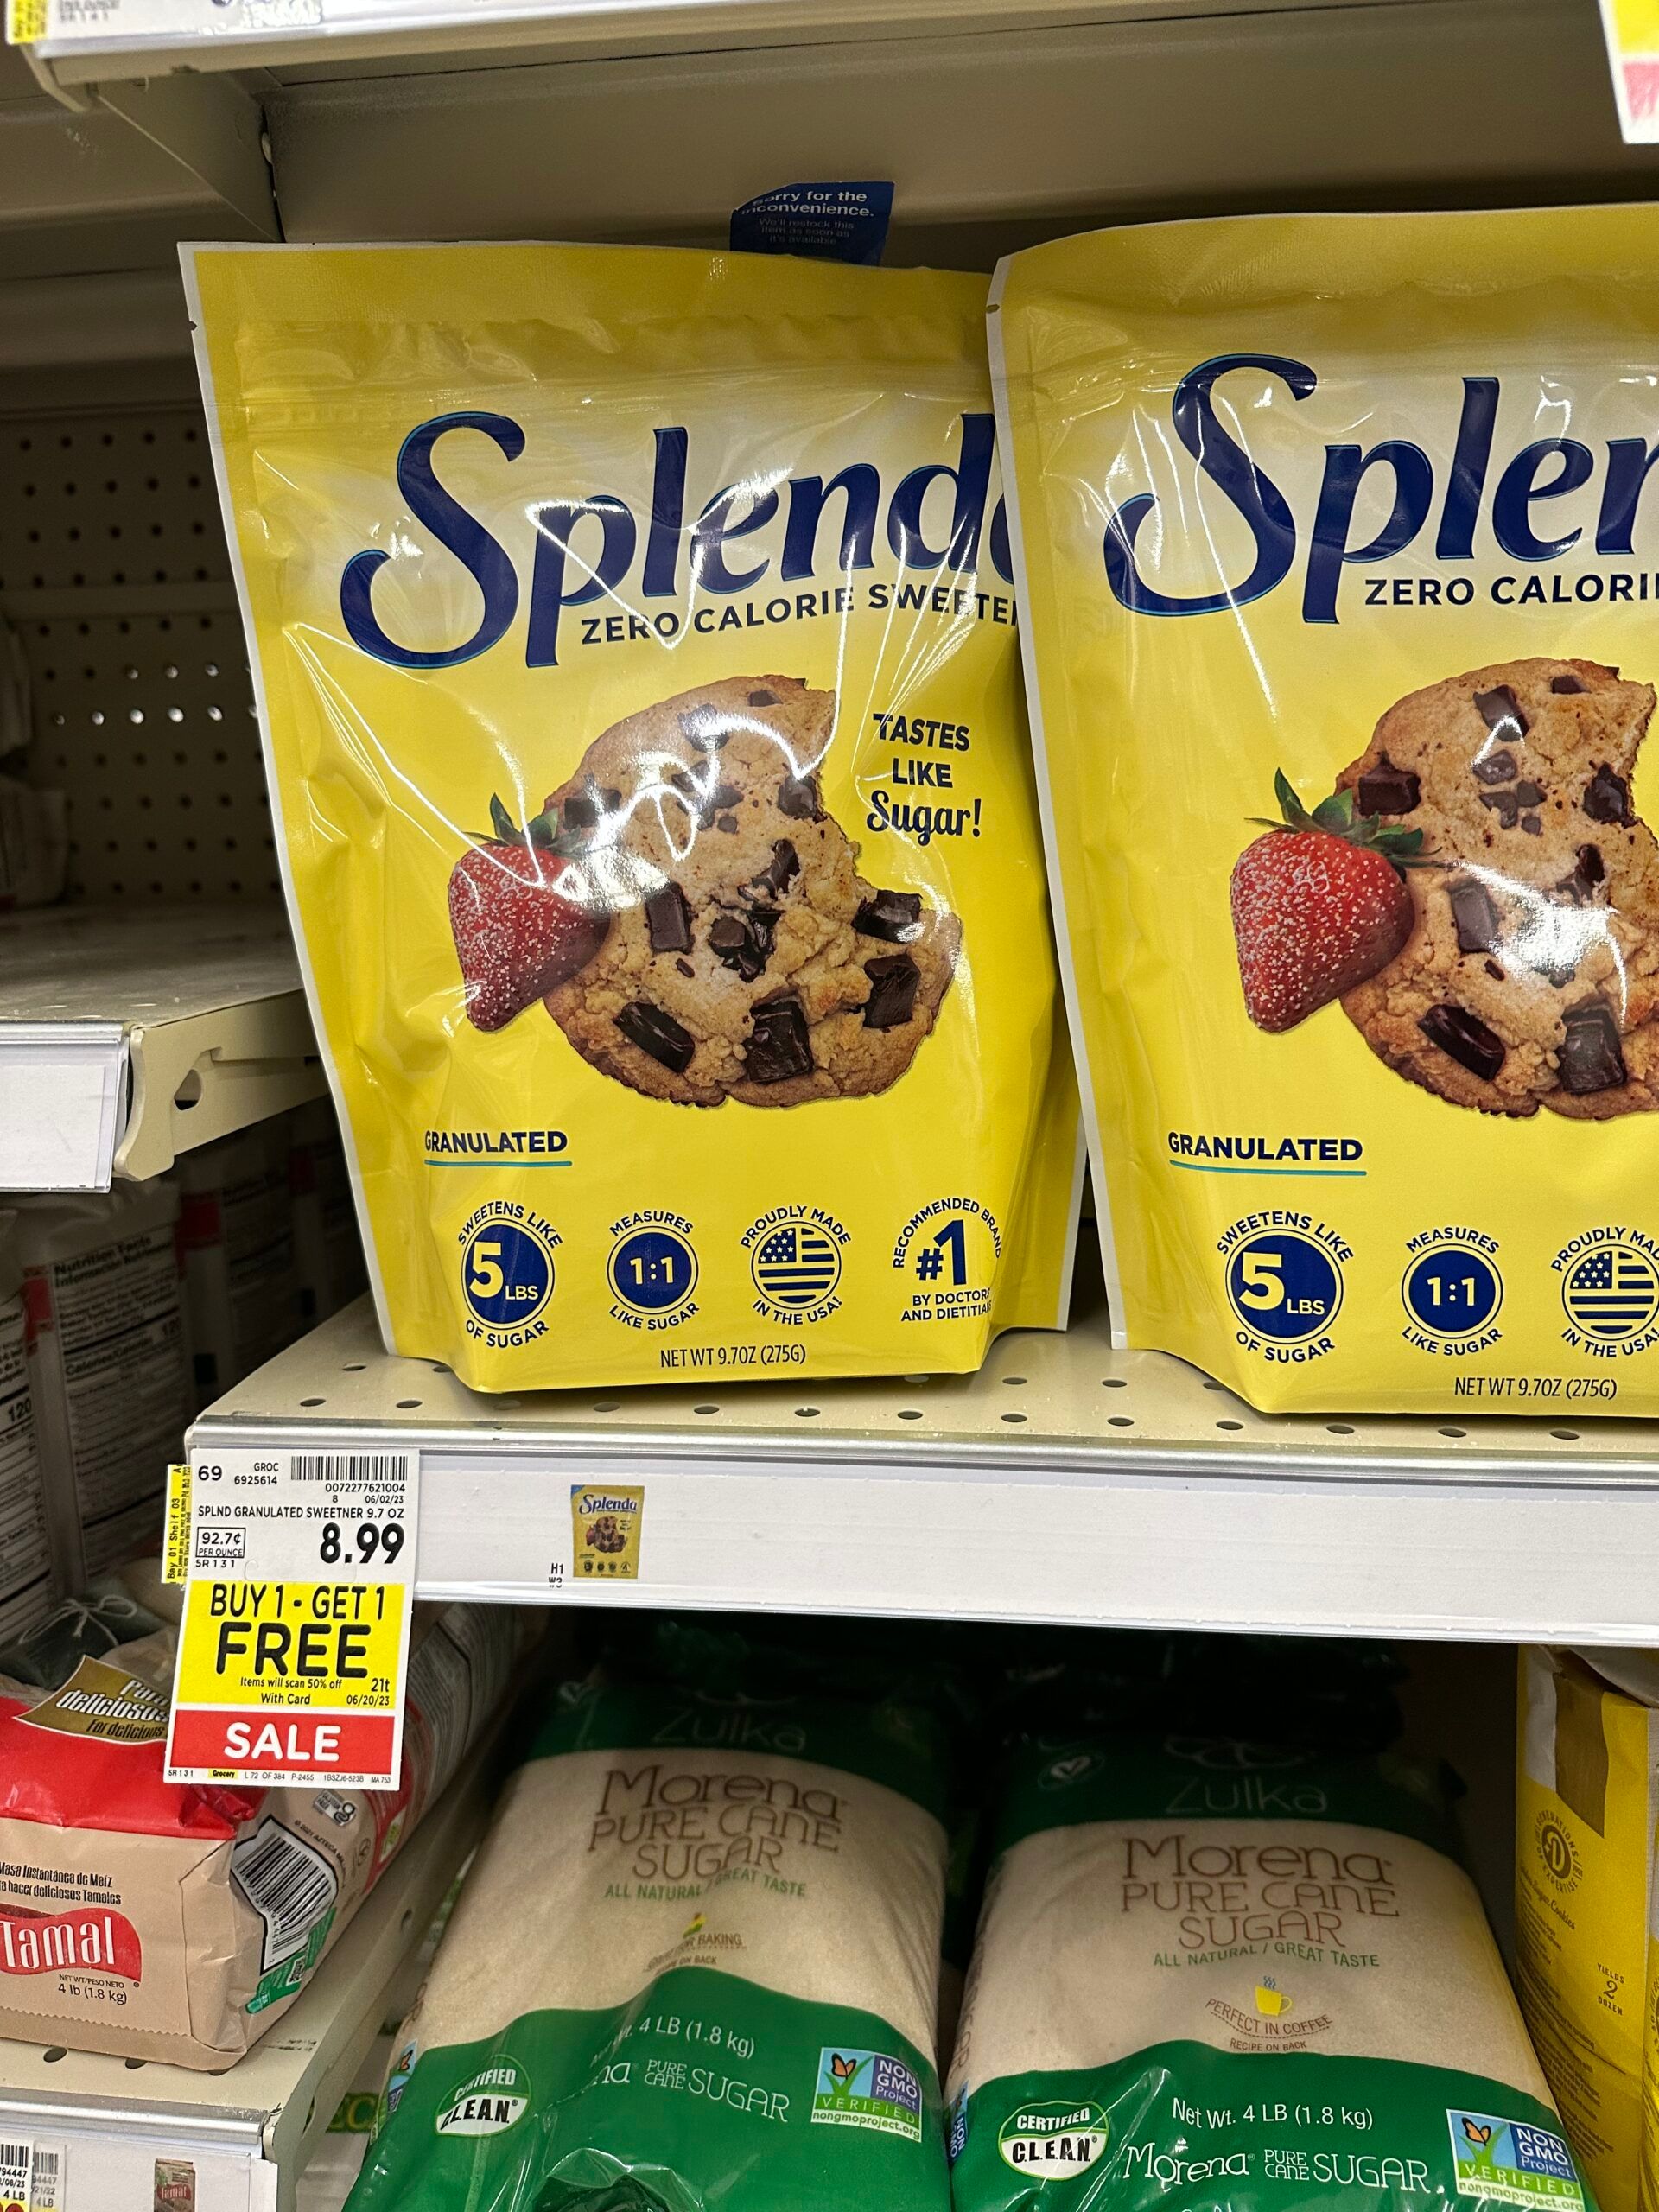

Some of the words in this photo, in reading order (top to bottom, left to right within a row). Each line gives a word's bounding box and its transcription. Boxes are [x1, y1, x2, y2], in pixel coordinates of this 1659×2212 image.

[806, 191, 833, 201] for
[838, 191, 867, 202] the
[834, 219, 855, 229] this
[1365, 577, 1475, 606] ZERO
[581, 612, 682, 645] ZERO
[694, 588, 854, 634] CALORIE
[868, 583, 1017, 626] SWEETE
[873, 713, 969, 752] TASTES
[892, 758, 953, 788] LIKE
[867, 790, 982, 846] Sugar!
[424, 1130, 568, 1153] GRANULATED
[1168, 1131, 1363, 1160] GRANULATED
[458, 1201, 524, 1245] SWEETENS
[526, 1211, 563, 1249] LIKE
[609, 1210, 695, 1237] MEASURES
[740, 1205, 808, 1249] PROUDLY
[810, 1208, 852, 1246] MADE
[893, 1198, 980, 1268] RECOMMENDED
[981, 1209, 1001, 1259] BRAND
[1217, 1211, 1313, 1255] SWEETENS
[1314, 1223, 1354, 1262] LIKE
[916, 1219, 967, 1286] #1
[469, 1241, 504, 1298] 5
[505, 1285, 539, 1300] LBS
[629, 1256, 675, 1285] 1:1
[752, 1299, 771, 1317] IN
[772, 1310, 804, 1325] THE
[806, 1295, 843, 1324] USA!
[912, 1294, 931, 1306] BY
[608, 1304, 642, 1329] LIKE
[647, 1301, 700, 1332] SUGAR
[465, 1319, 484, 1340] OF
[486, 1319, 550, 1349] SUGAR
[661, 1350, 686, 1368] NET
[690, 1350, 713, 1367] WT
[760, 1344, 806, 1366] (275G)
[8, 1396, 33, 1423] 120
[198, 1465, 222, 1481] 69
[254, 1462, 279, 1471] GROC
[233, 1476, 278, 1485] 6925614
[325, 1483, 405, 1493] 0072277621004
[171, 1497, 180, 1509] 03
[198, 1505, 232, 1517] SPLND
[234, 1506, 302, 1518] GRANULATED
[306, 1507, 363, 1519] SWEETNER
[366, 1508, 384, 1518] 9.7
[387, 1508, 404, 1519] OZ
[332, 1495, 338, 1503] 8
[365, 1495, 404, 1504] 06/02/23
[169, 1515, 179, 1541] Shelf
[199, 1548, 213, 1556] PER
[215, 1548, 243, 1556] OUNCE
[320, 1522, 405, 1564] 8.99
[167, 1562, 178, 1580] Bay
[550, 1563, 563, 1574] H1
[210, 1584, 267, 1617] BUY
[276, 1584, 283, 1618] 1
[312, 1586, 366, 1620] GET
[375, 1586, 385, 1620] 1
[216, 1622, 372, 1678] FREE
[240, 1677, 265, 1688] Items
[267, 1678, 283, 1688] will
[308, 1679, 327, 1689] 50%
[329, 1679, 342, 1689] off
[261, 1692, 284, 1704] With
[287, 1694, 311, 1705] Card
[346, 1695, 390, 1707] 06/20/23
[86, 1719, 108, 1733] For
[224, 1722, 341, 1762] SALE
[1166, 1777, 1328, 1815] Zulka
[588, 1805, 709, 1853] PURE
[718, 1803, 842, 1853] CANE
[633, 1835, 784, 1880] SUGAR
[77, 1872, 88, 1885] de
[605, 1884, 631, 1898] ALL
[637, 1884, 703, 1900] NATURAL
[762, 1873, 807, 1897] TASTE
[8, 1880, 33, 1896] hacer
[34, 1885, 81, 1902] deliciosos
[83, 1890, 122, 1905] Tamales
[1121, 1880, 1249, 1913] PURE
[1262, 1881, 1400, 1918] CANE
[0, 1916, 115, 1970] Tamal
[698, 1933, 743, 1946] BAKING
[1179, 1910, 1346, 1949] SUGAR
[1154, 1952, 1180, 1967] ALL
[1187, 1945, 1258, 1967] NATURAL
[1274, 1942, 1325, 1963] GREAT
[1330, 1950, 1381, 1967] TASTE
[105, 1980, 124, 1988] NETO
[1597, 1962, 1625, 1984] YIELDS
[58, 1984, 67, 1993] 4
[69, 1985, 80, 1995] lb
[84, 1986, 105, 1999] (1.8
[108, 1990, 127, 2005] kg)
[1603, 1980, 1618, 1999] 2
[1205, 1998, 1261, 2035] PERFECT
[1264, 2022, 1279, 2035] IN
[1282, 2013, 1333, 2035] COFFEE
[1598, 1996, 1624, 2016] DOZEN
[1230, 2038, 1262, 2051] RECIPE
[1265, 2039, 1280, 2051] ON
[1281, 2039, 1307, 2051] BACK
[1017, 2107, 1090, 2131] CERTIFIED
[1173, 2097, 1202, 2128] Net
[1206, 2108, 1236, 2130] Wt.
[1243, 2104, 1255, 2122] 4
[1262, 2103, 1287, 2122] LB
[1296, 2104, 1334, 2127] (1.8
[1341, 2107, 1373, 2129] kg)
[1516, 2127, 1565, 2154] NON
[1519, 2141, 1569, 2166] GMO
[1264, 2149, 1307, 2166] PURE
[1521, 2155, 1572, 2178] Project
[1264, 2164, 1310, 2181] CANE
[1313, 2153, 1431, 2193] SUGAR
[1464, 2164, 1575, 2196] VERIFIED
[1459, 2180, 1584, 2212] nongmoproject.org
